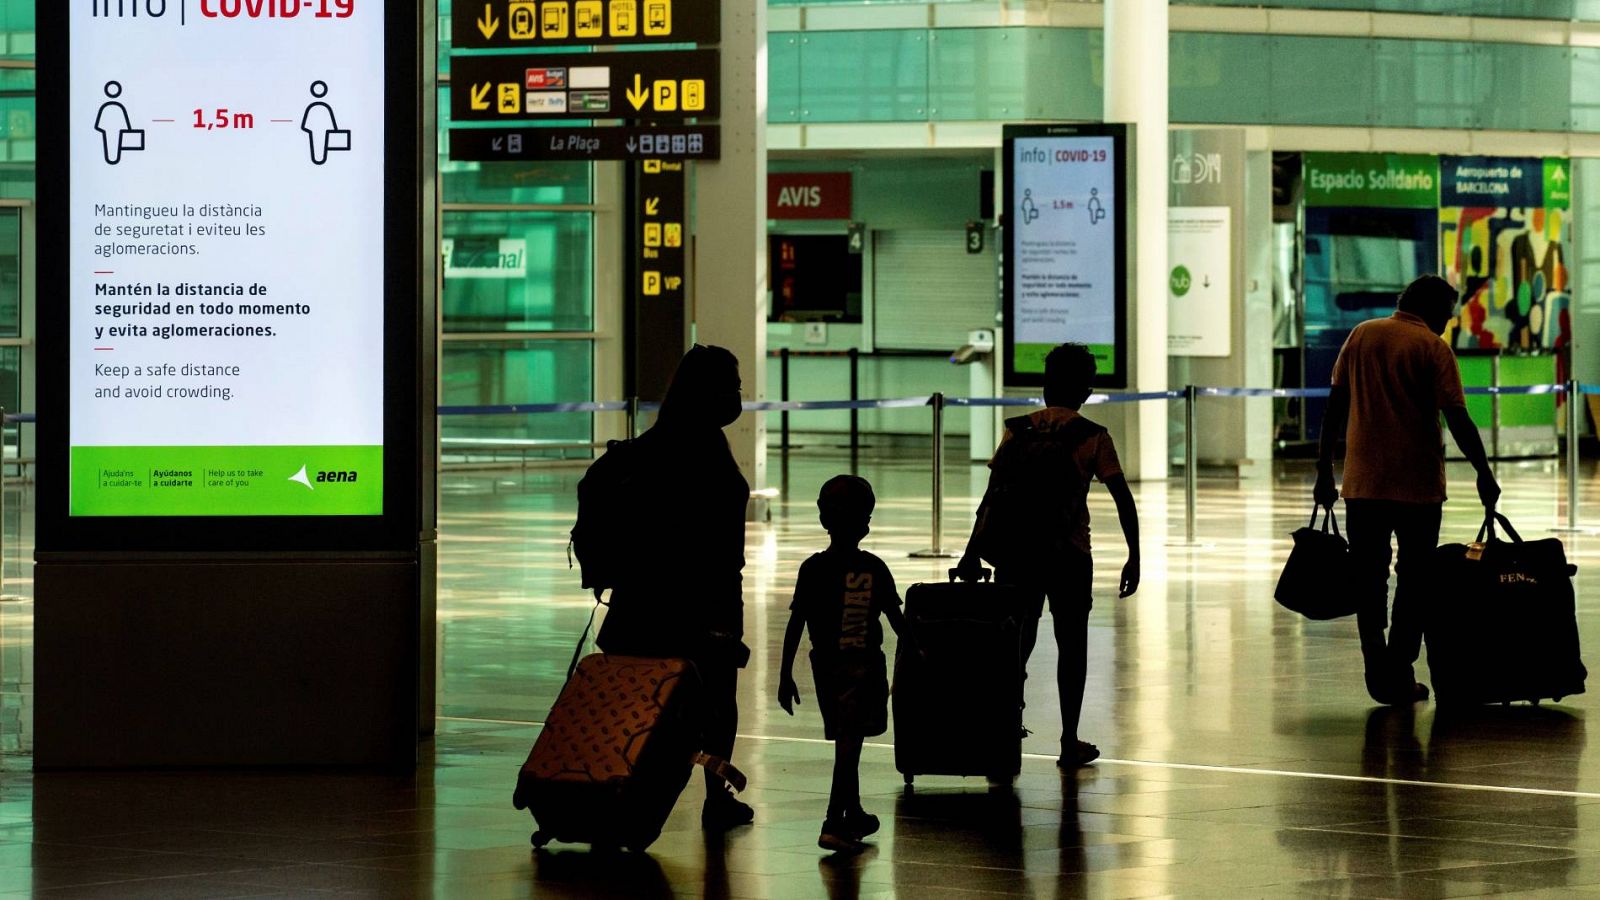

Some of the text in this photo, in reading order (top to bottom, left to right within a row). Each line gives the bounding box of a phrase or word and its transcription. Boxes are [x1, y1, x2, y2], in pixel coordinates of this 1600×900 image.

[200, 0, 354, 18] COVID-19
[550, 135, 600, 154] La Plaça
[1021, 148, 1107, 163] info COVID-19
[1310, 168, 1434, 194] Espacio Solidario
[1456, 181, 1509, 195] BARCELONA
[777, 186, 821, 207] AVIS
[94, 203, 262, 220] Mantingueu la distància
[94, 223, 112, 236] de
[117, 224, 185, 239] seguretat
[197, 223, 240, 236] eviteu
[246, 223, 266, 236] les
[850, 232, 861, 249] 4
[970, 232, 981, 249] 3
[94, 242, 200, 258] aglomeracions.
[95, 282, 267, 296] Mantén la distancia de
[664, 276, 682, 291] VIP
[94, 302, 311, 318] seguridad en todo momento
[94, 324, 277, 340] y evita aglomeraciones.
[95, 363, 240, 380] Keep a safe distance
[94, 385, 234, 401] and avoid crowding.
[103, 469, 134, 480] Ajuda'ns
[153, 469, 193, 480] Ayúdanos
[208, 469, 225, 481] Help
[236, 470, 245, 478] to
[247, 469, 264, 478] take
[316, 470, 358, 483] aena
[110, 479, 142, 487] cuidar-te
[160, 479, 193, 487] cuidarte
[207, 478, 249, 489] care of you
